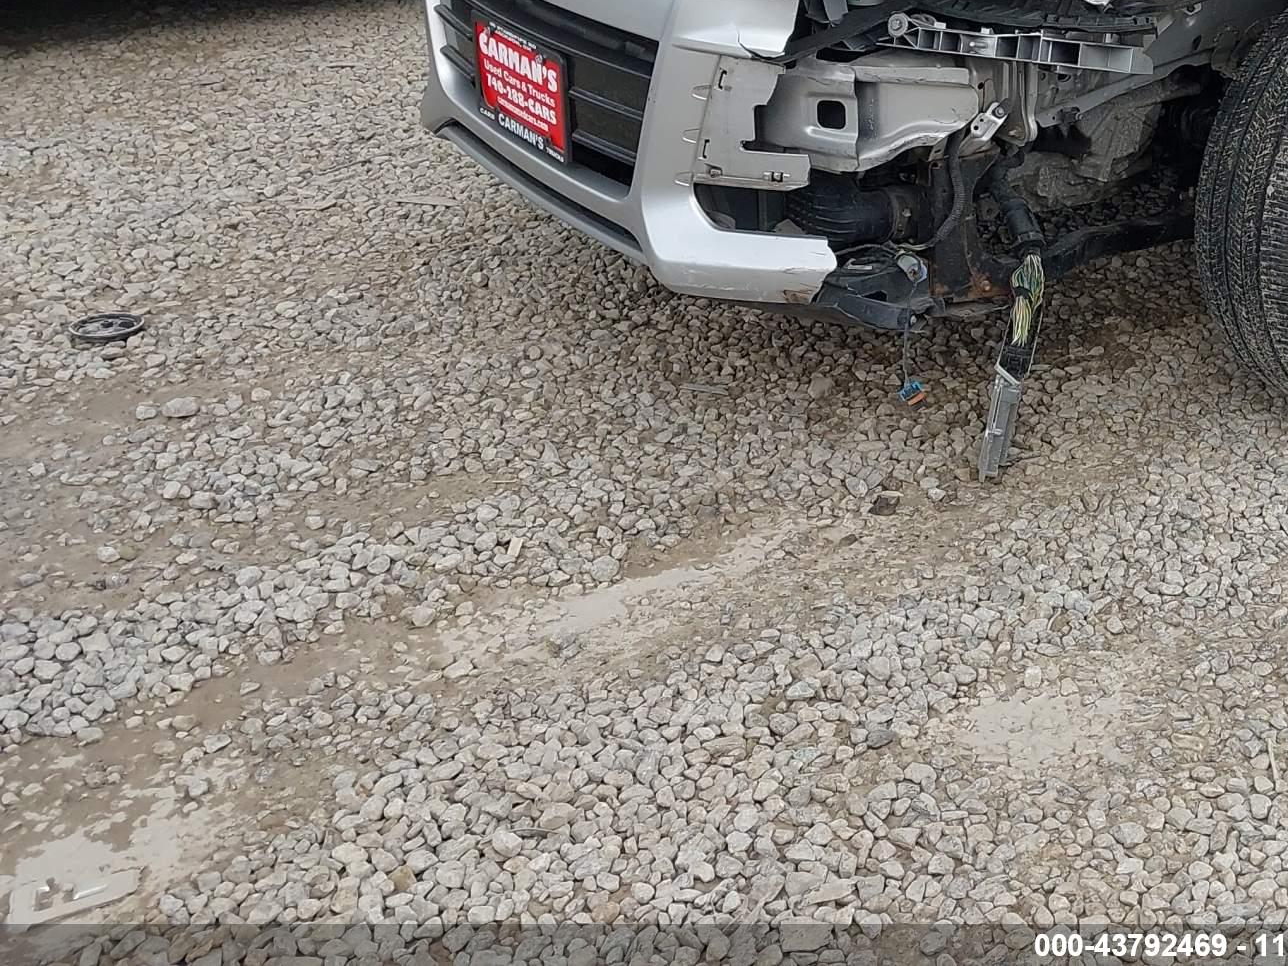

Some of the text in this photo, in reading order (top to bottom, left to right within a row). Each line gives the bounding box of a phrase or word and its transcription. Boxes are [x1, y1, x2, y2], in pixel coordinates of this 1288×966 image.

[479, 31, 558, 93] CARMAN'S
[484, 58, 503, 78] Used
[503, 69, 521, 89] Cars
[527, 83, 556, 108] Trucks
[498, 114, 545, 150] CARMAN'S
